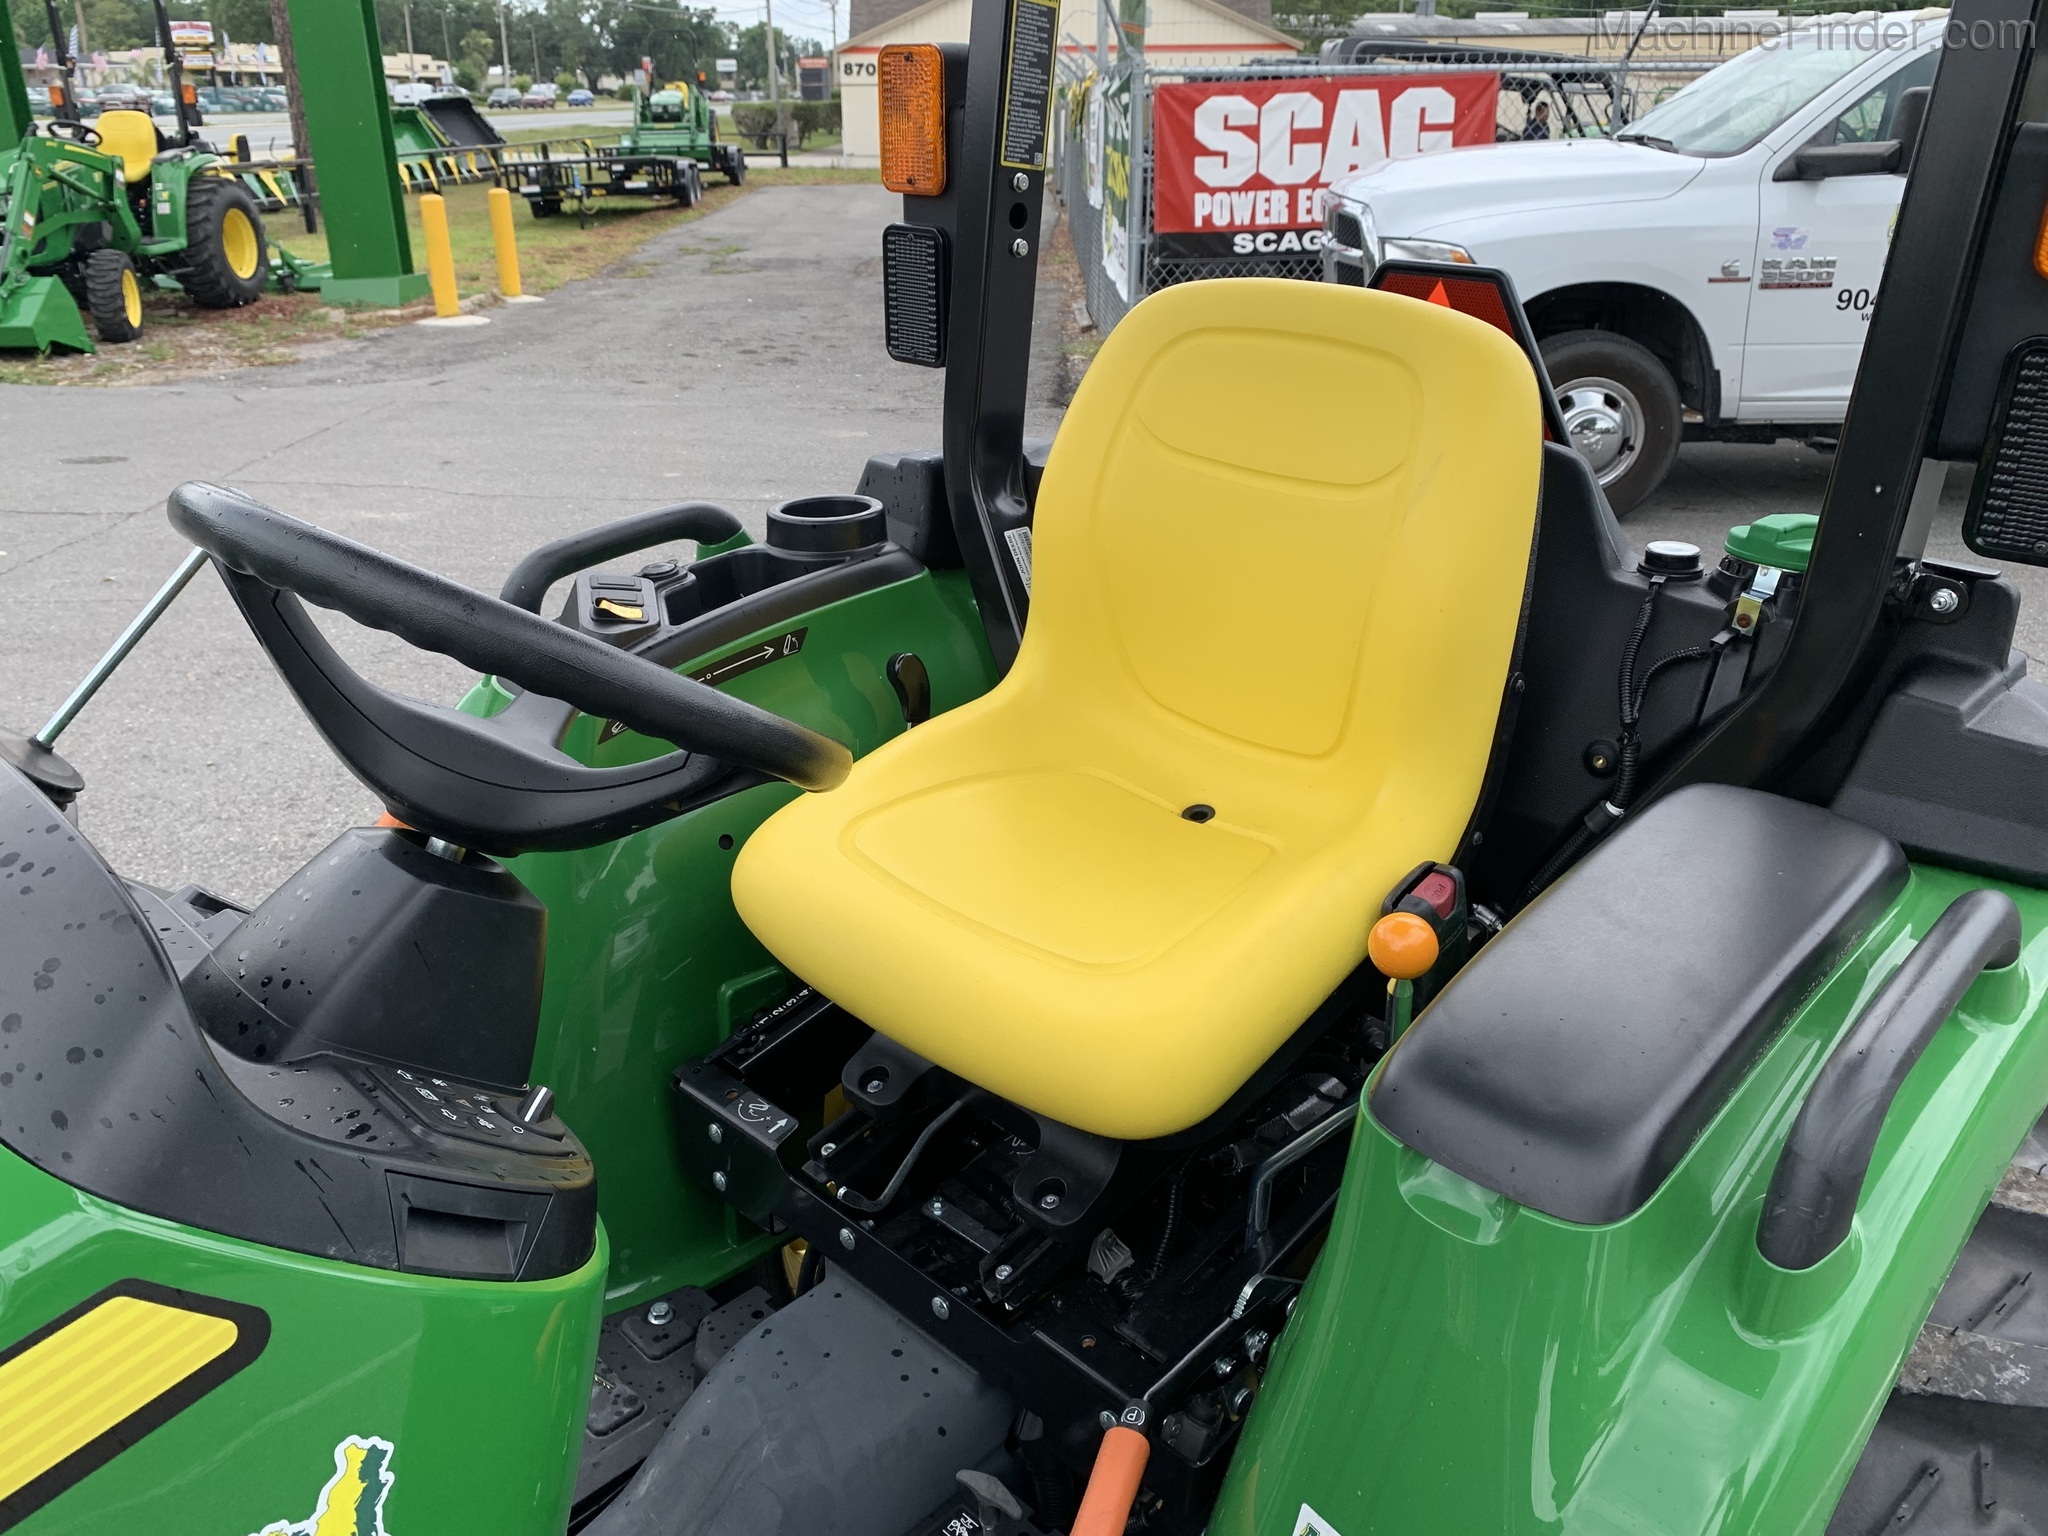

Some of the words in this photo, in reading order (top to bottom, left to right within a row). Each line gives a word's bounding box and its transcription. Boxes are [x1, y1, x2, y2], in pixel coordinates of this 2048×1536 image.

[1194, 87, 1456, 187] SCAG
[1194, 189, 1289, 227] POWER
[1233, 230, 1324, 254] SCAG
[1762, 256, 1837, 270] RAM
[1015, 557, 1026, 575] JOHN
